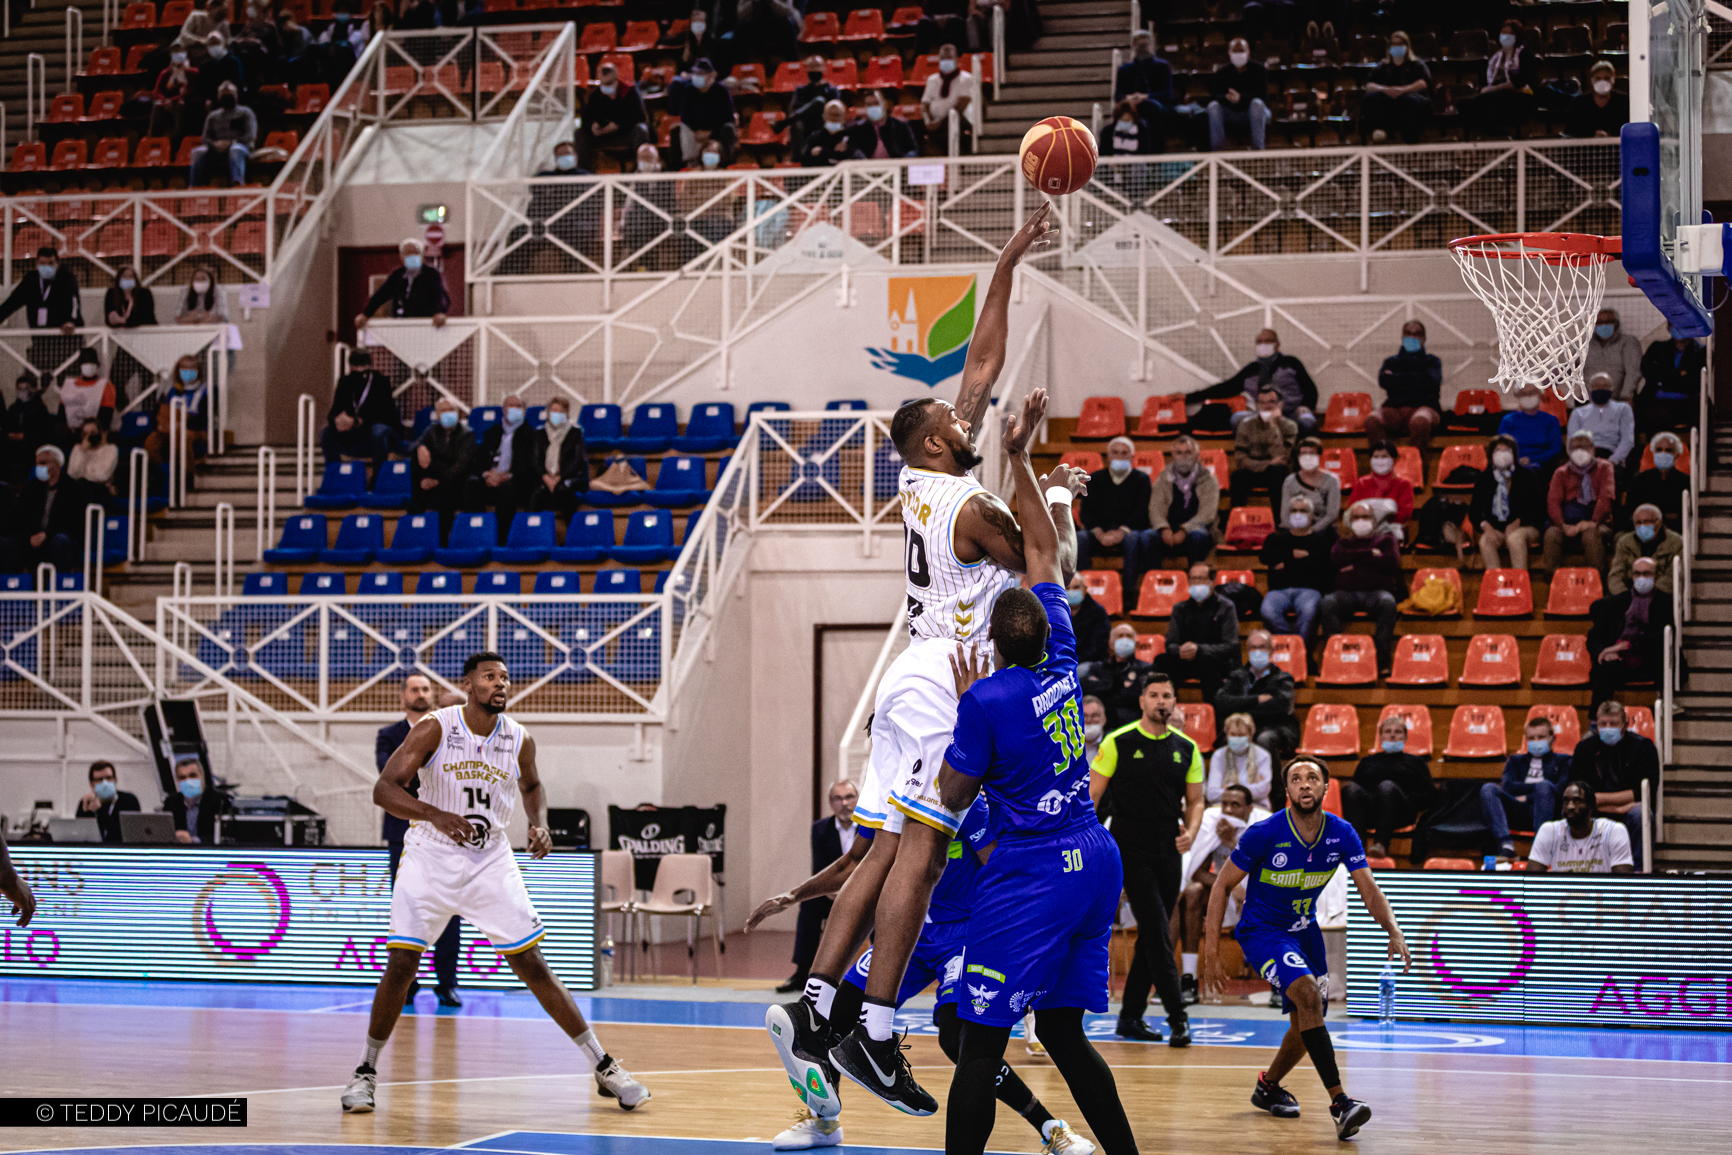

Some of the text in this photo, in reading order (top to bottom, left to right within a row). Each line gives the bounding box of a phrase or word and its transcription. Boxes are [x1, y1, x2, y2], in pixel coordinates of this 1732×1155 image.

[1042, 694, 1085, 776] 30
[442, 760, 510, 781] CHAMPAGNE
[455, 770, 499, 785] BASKET
[463, 787, 490, 809] 14
[618, 834, 685, 855] SPALDING
[1061, 849, 1083, 873] 30
